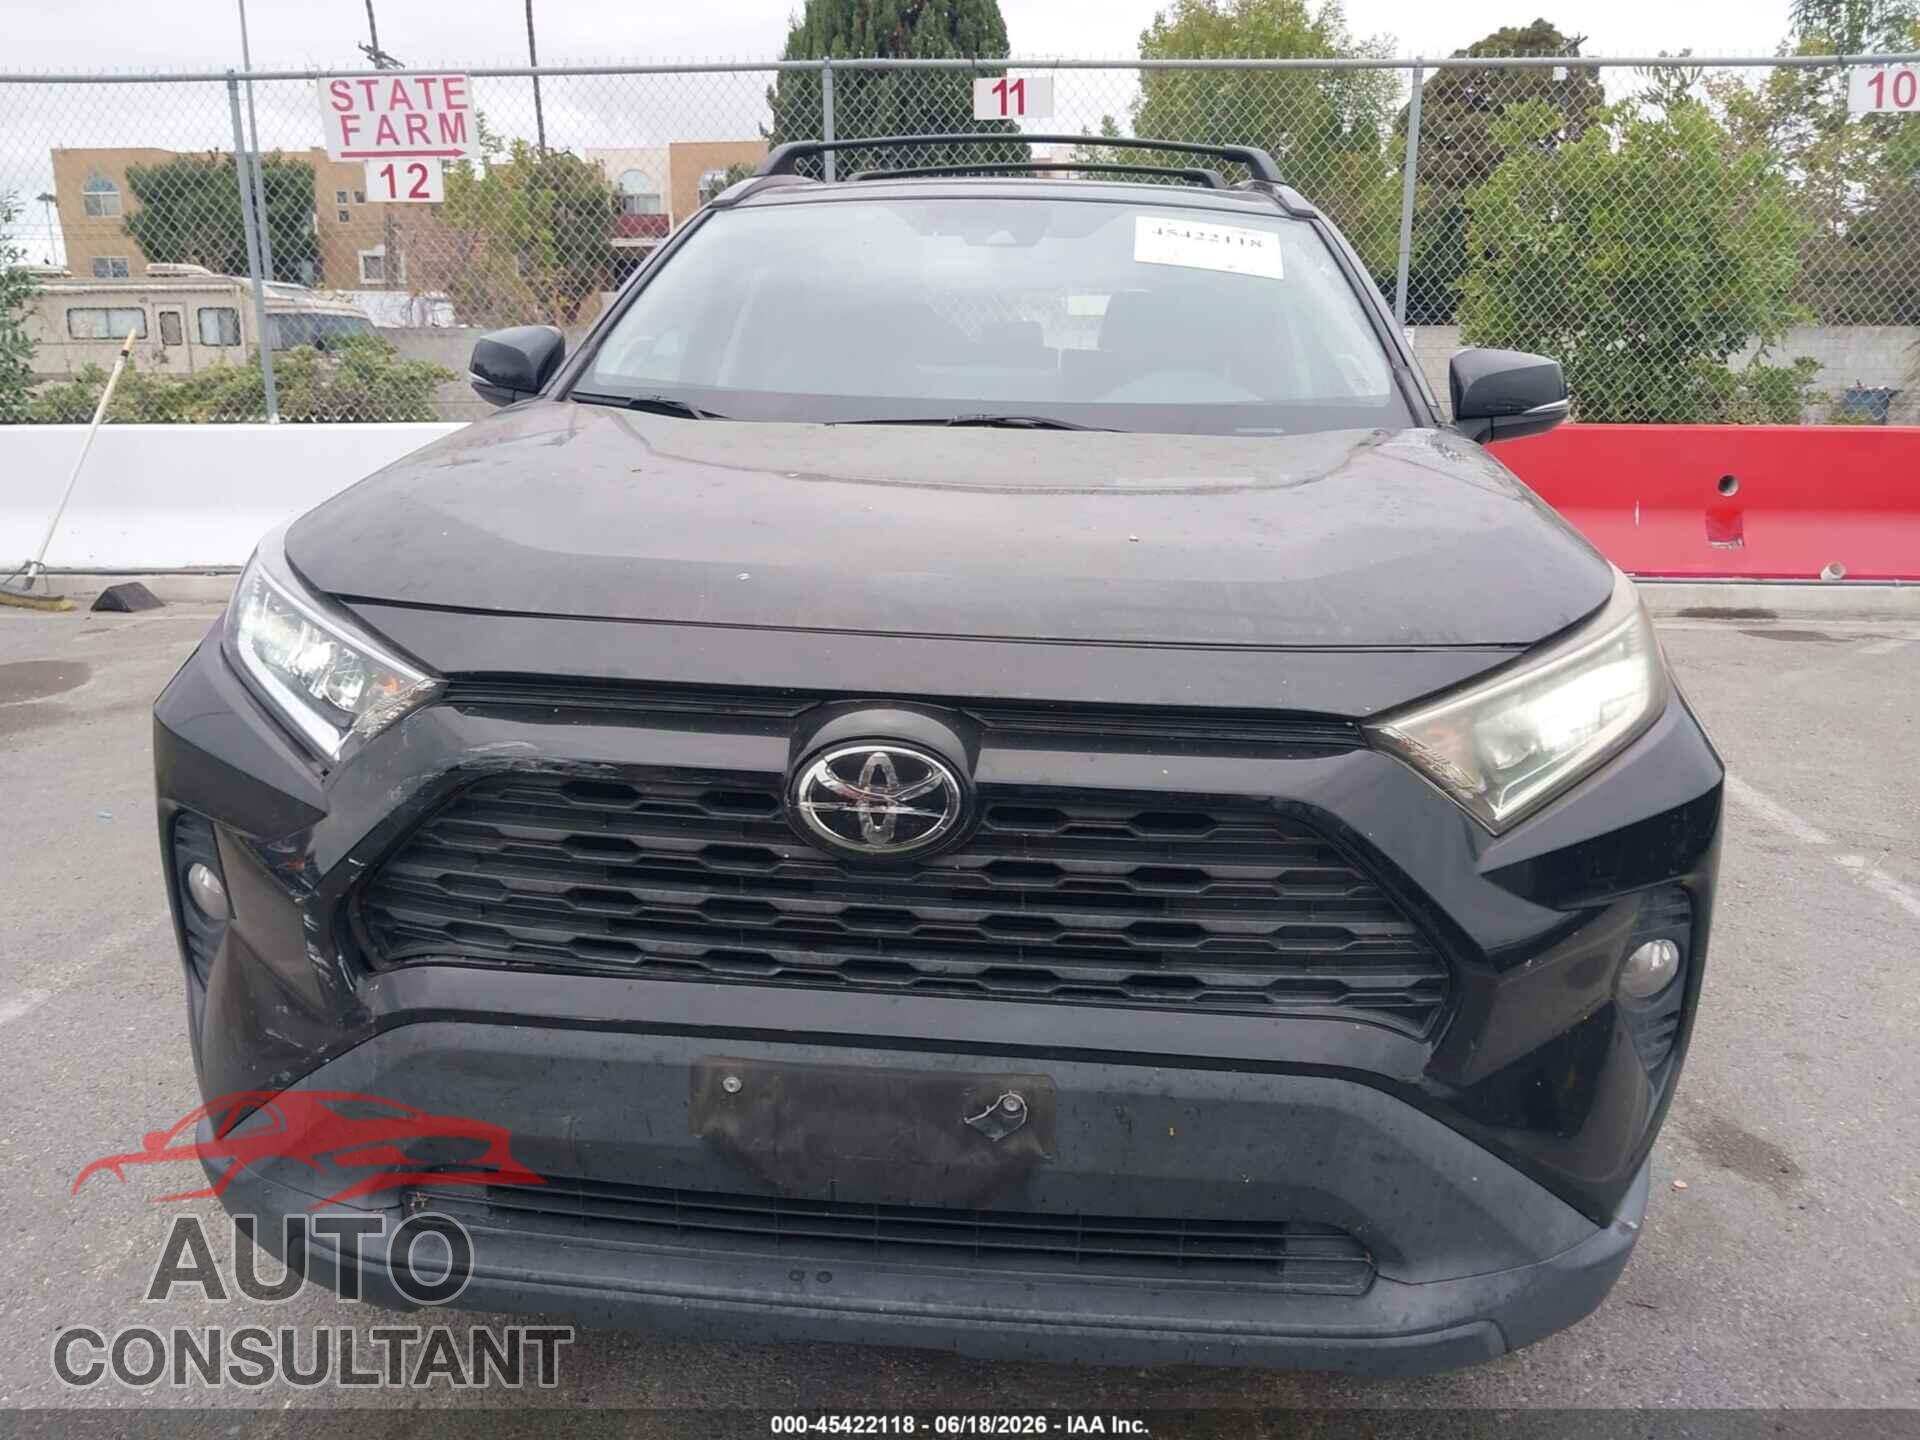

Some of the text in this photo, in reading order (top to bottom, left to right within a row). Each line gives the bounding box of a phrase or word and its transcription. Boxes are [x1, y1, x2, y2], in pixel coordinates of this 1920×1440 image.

[329, 77, 468, 112] STATE
[992, 78, 1025, 116] 11
[1867, 70, 1917, 108] 10
[340, 112, 467, 146] FARM
[380, 162, 430, 199] 12
